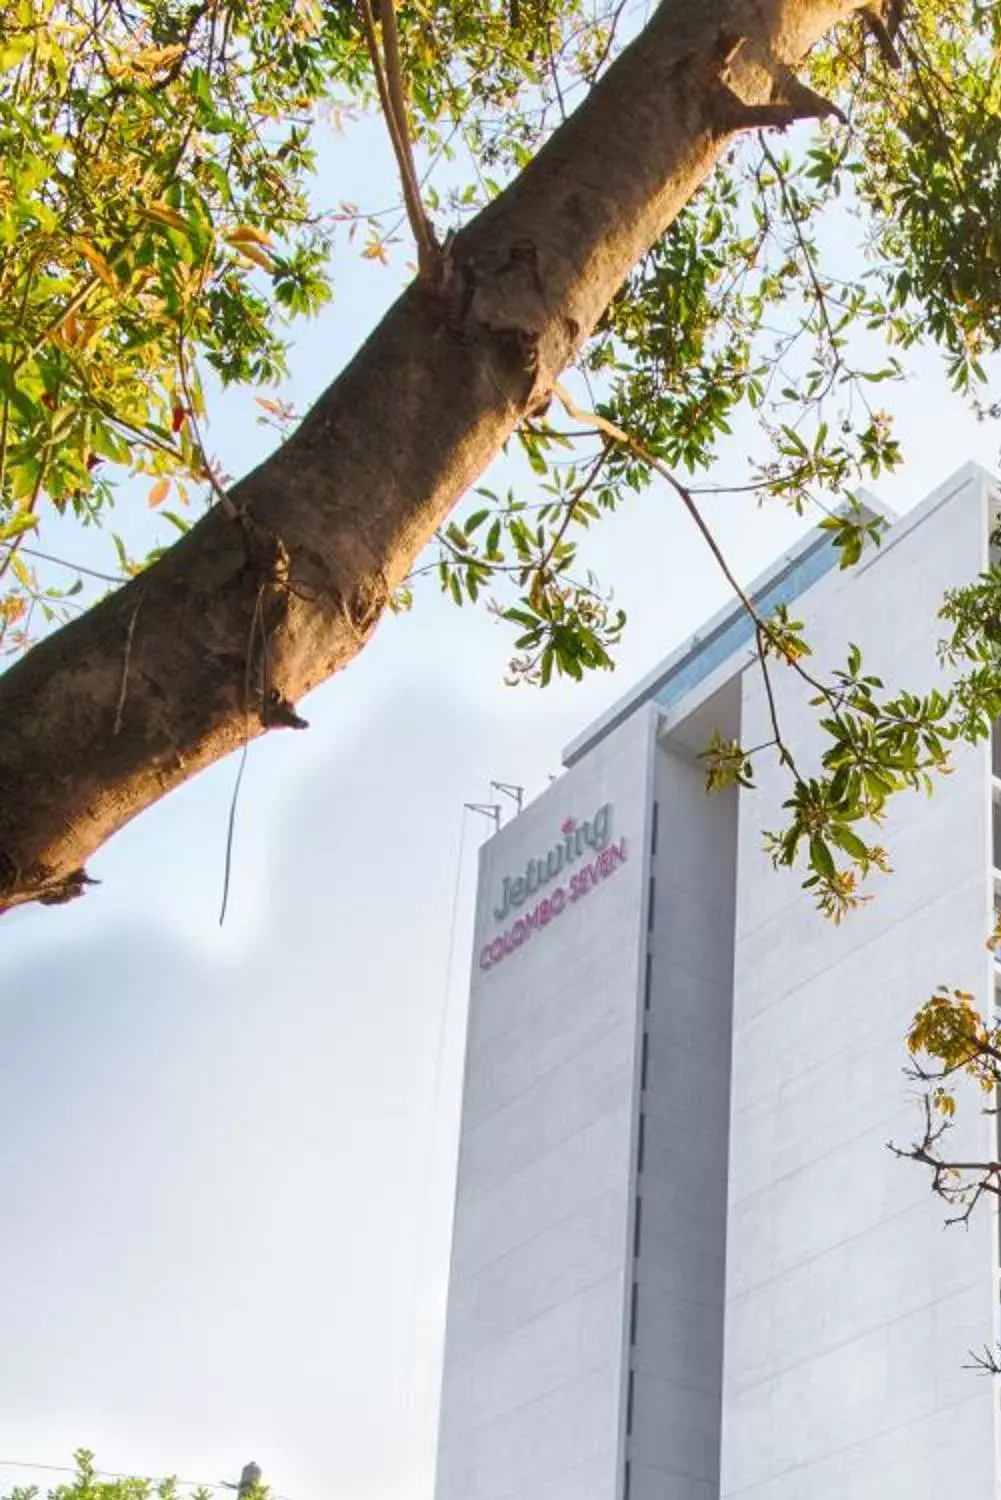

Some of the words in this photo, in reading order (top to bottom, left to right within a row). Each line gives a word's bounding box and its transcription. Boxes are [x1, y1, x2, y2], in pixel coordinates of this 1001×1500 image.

[480, 887, 566, 970] COLOMBO
[569, 837, 628, 902] SEVEN
[493, 803, 611, 920] Jetwing
